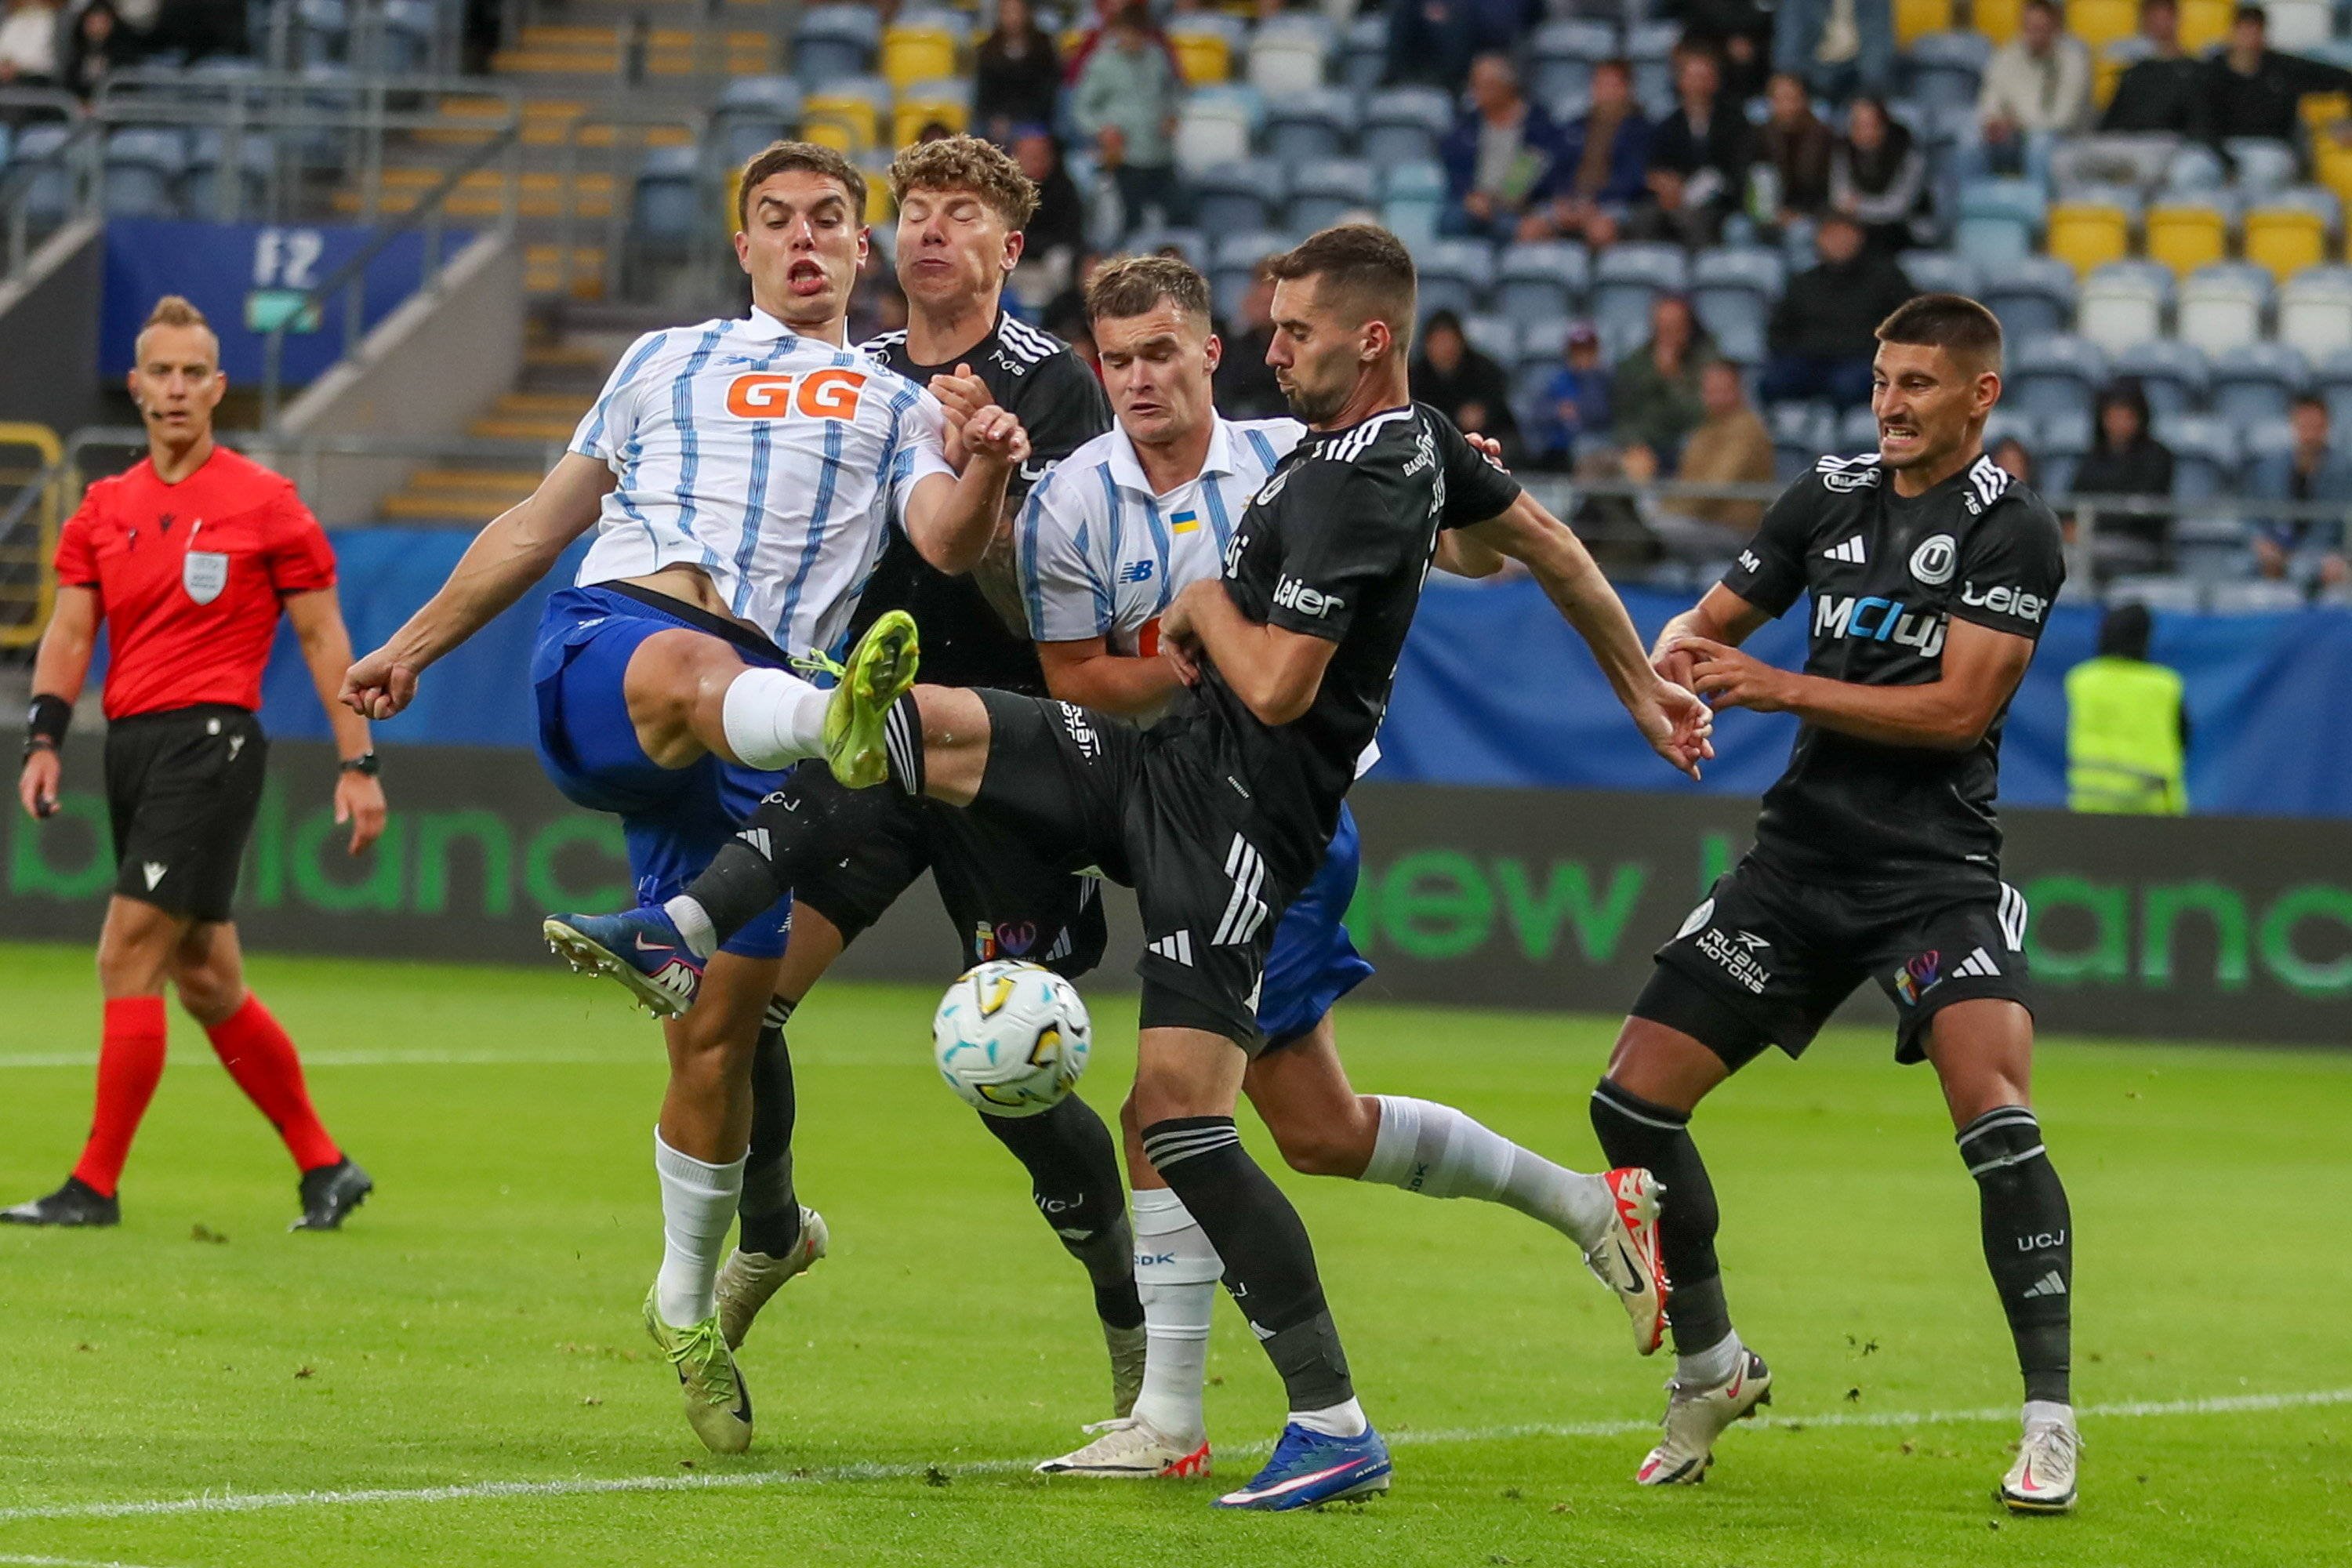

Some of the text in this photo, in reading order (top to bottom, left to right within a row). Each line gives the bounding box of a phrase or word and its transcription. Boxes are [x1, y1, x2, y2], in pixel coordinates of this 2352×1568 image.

[724, 366, 868, 423] GG
[1961, 580, 2048, 623] Leier
[9, 771, 629, 915] blanc
[1343, 850, 1643, 961] ew
[1695, 937, 1765, 994] MOTORS
[1706, 927, 1771, 983] RUBIN
[2017, 1229, 2064, 1251] UCJ
